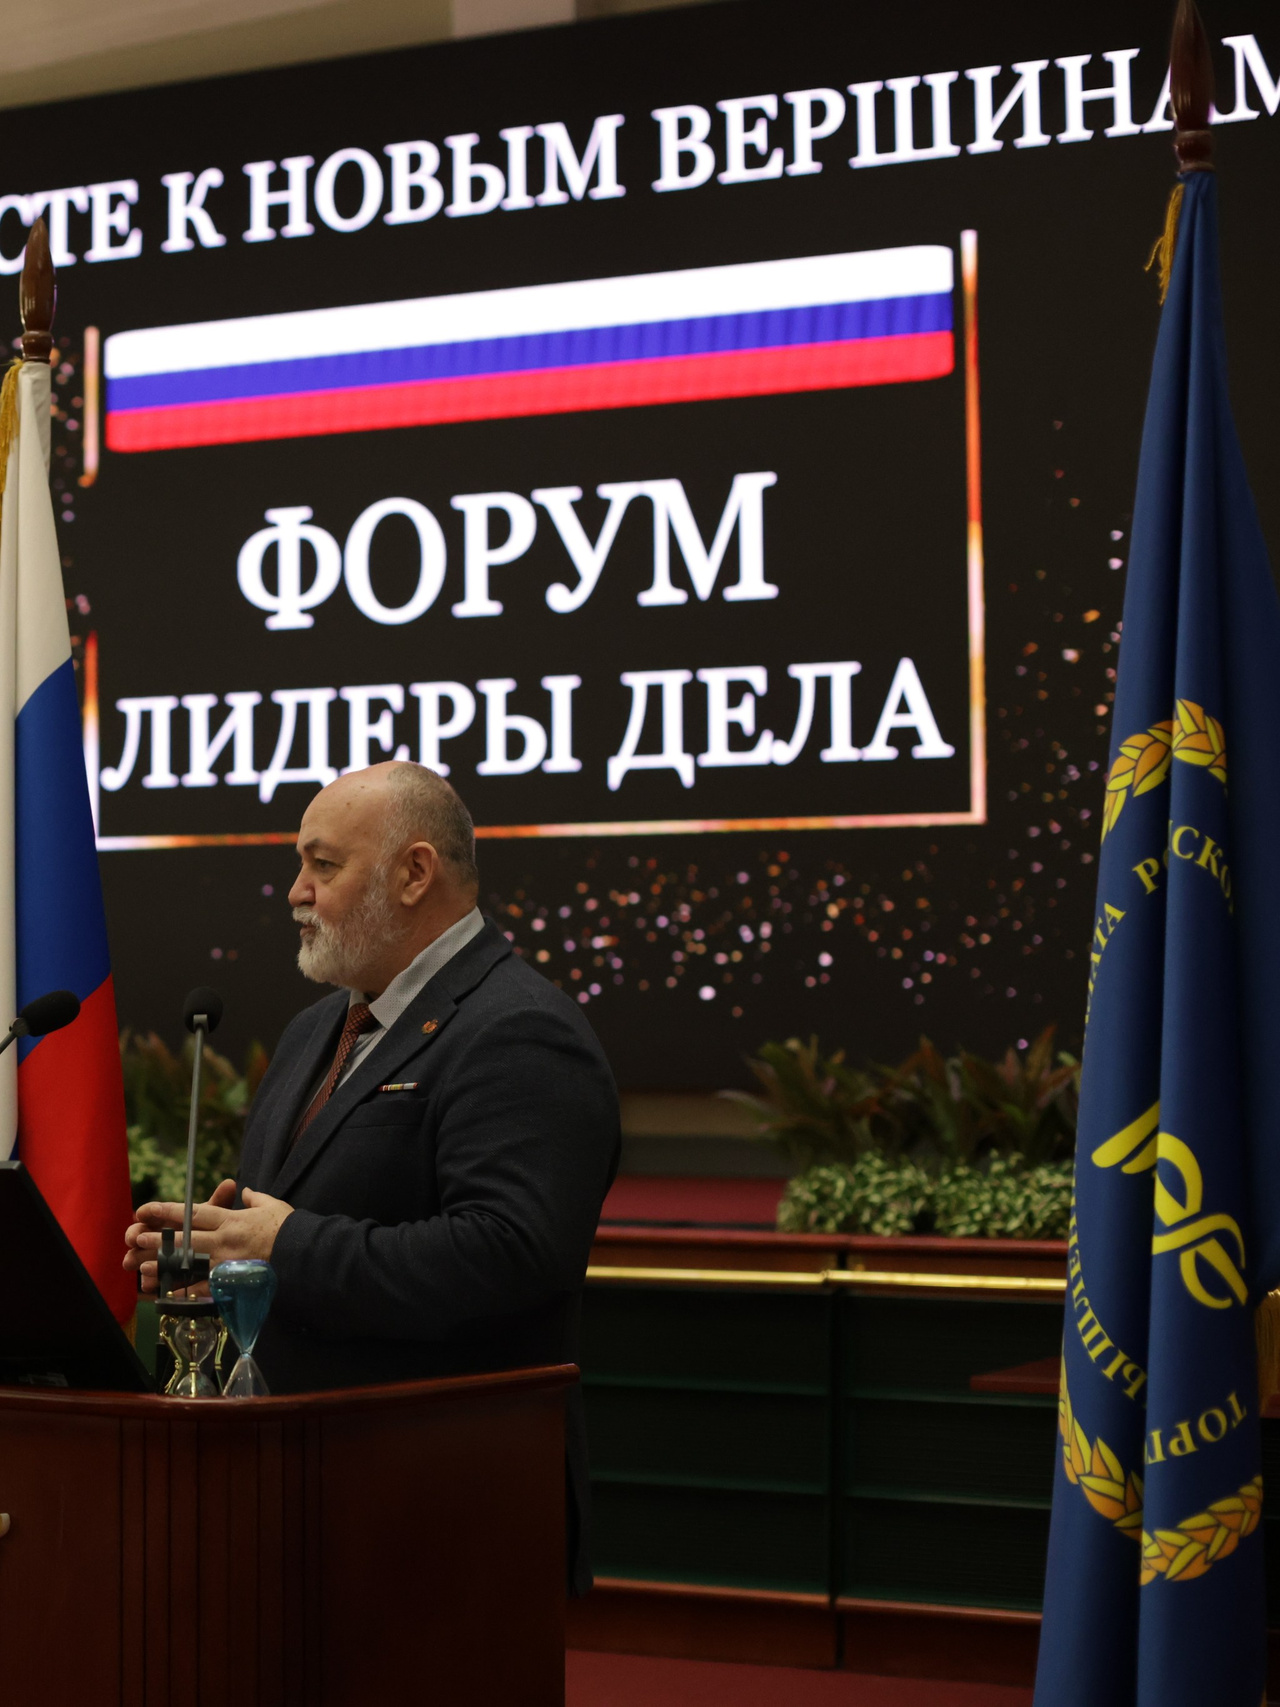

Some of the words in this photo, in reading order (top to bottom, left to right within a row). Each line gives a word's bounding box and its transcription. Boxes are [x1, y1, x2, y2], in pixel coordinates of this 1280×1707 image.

[161, 167, 226, 253] К
[243, 114, 626, 242] НОВЫМ
[237, 471, 779, 630] ФОРУМ
[99, 674, 582, 803] ЛИДЕРЫ
[607, 657, 955, 791] ДЕЛА
